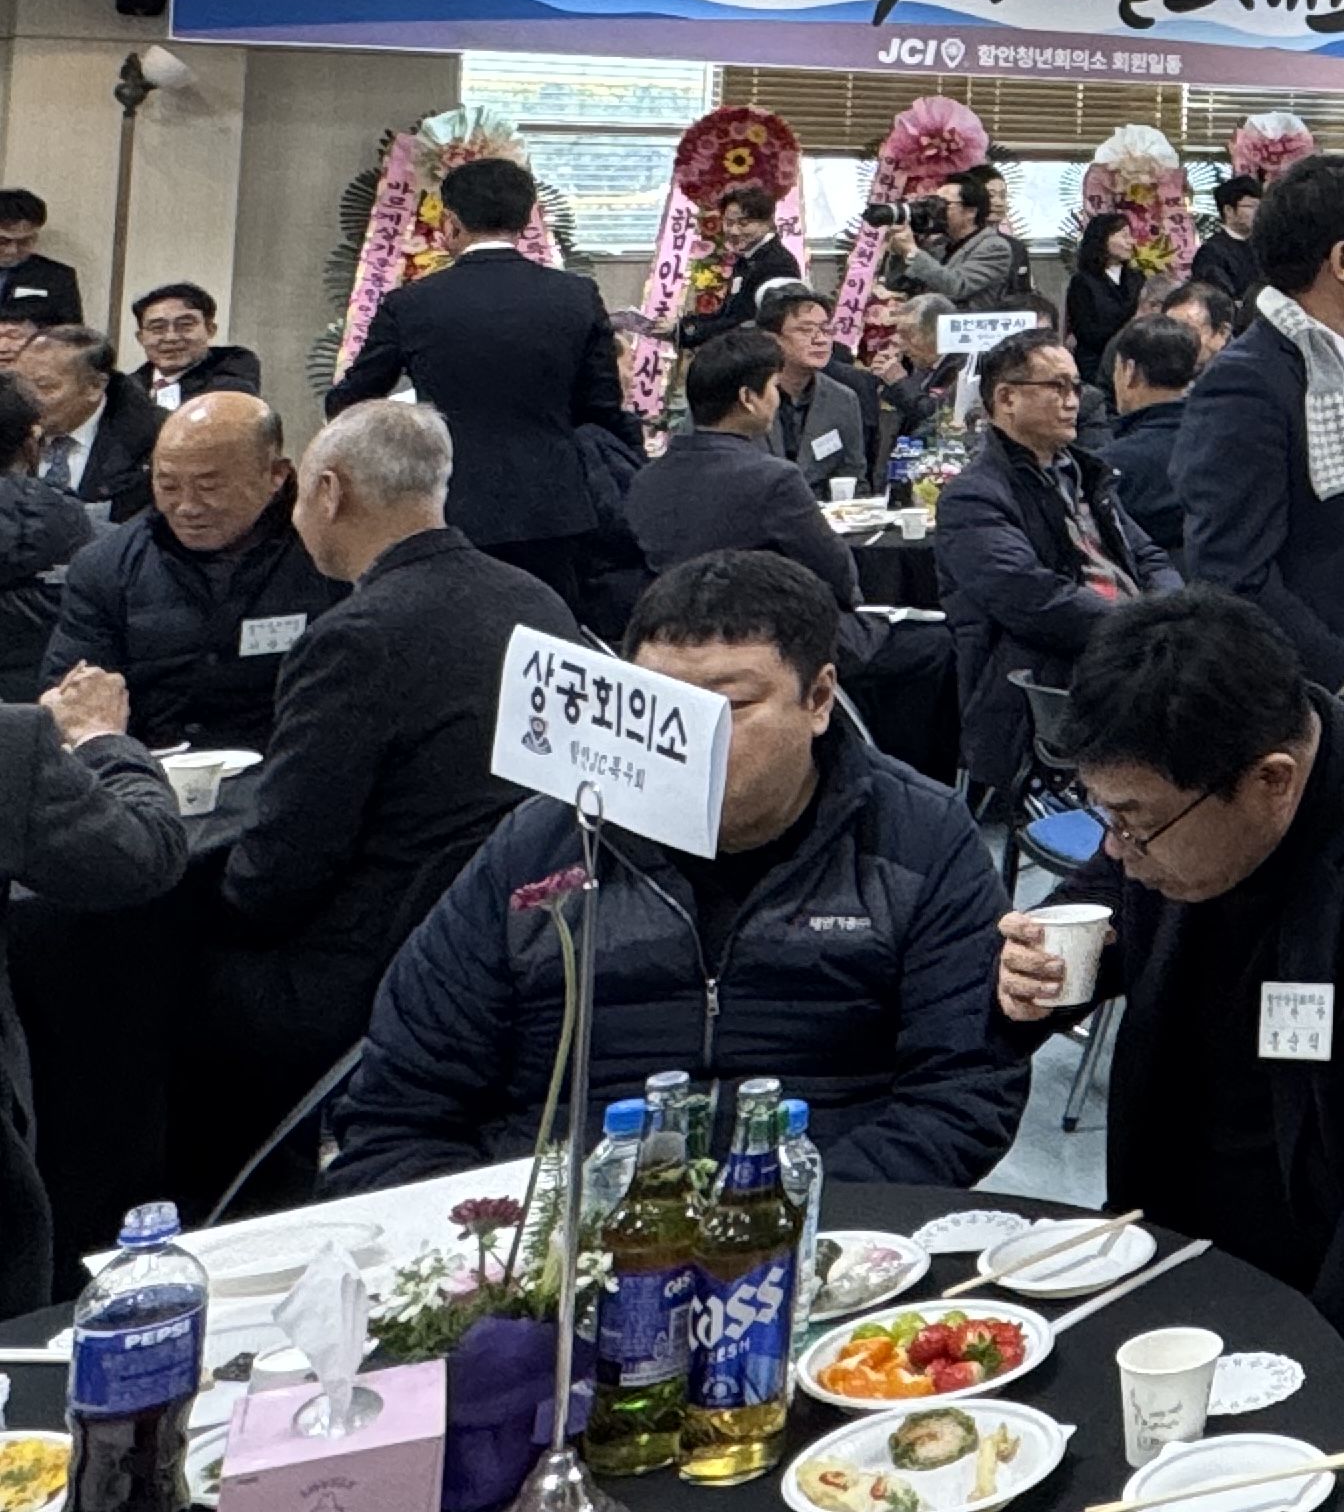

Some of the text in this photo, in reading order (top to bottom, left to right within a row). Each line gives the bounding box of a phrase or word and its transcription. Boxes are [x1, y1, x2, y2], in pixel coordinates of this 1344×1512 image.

[878, 37, 1184, 76] JCI 함안청년회의소 회원일동
[521, 650, 688, 765] 상공회의소
[124, 1318, 193, 1350] PEPSI
